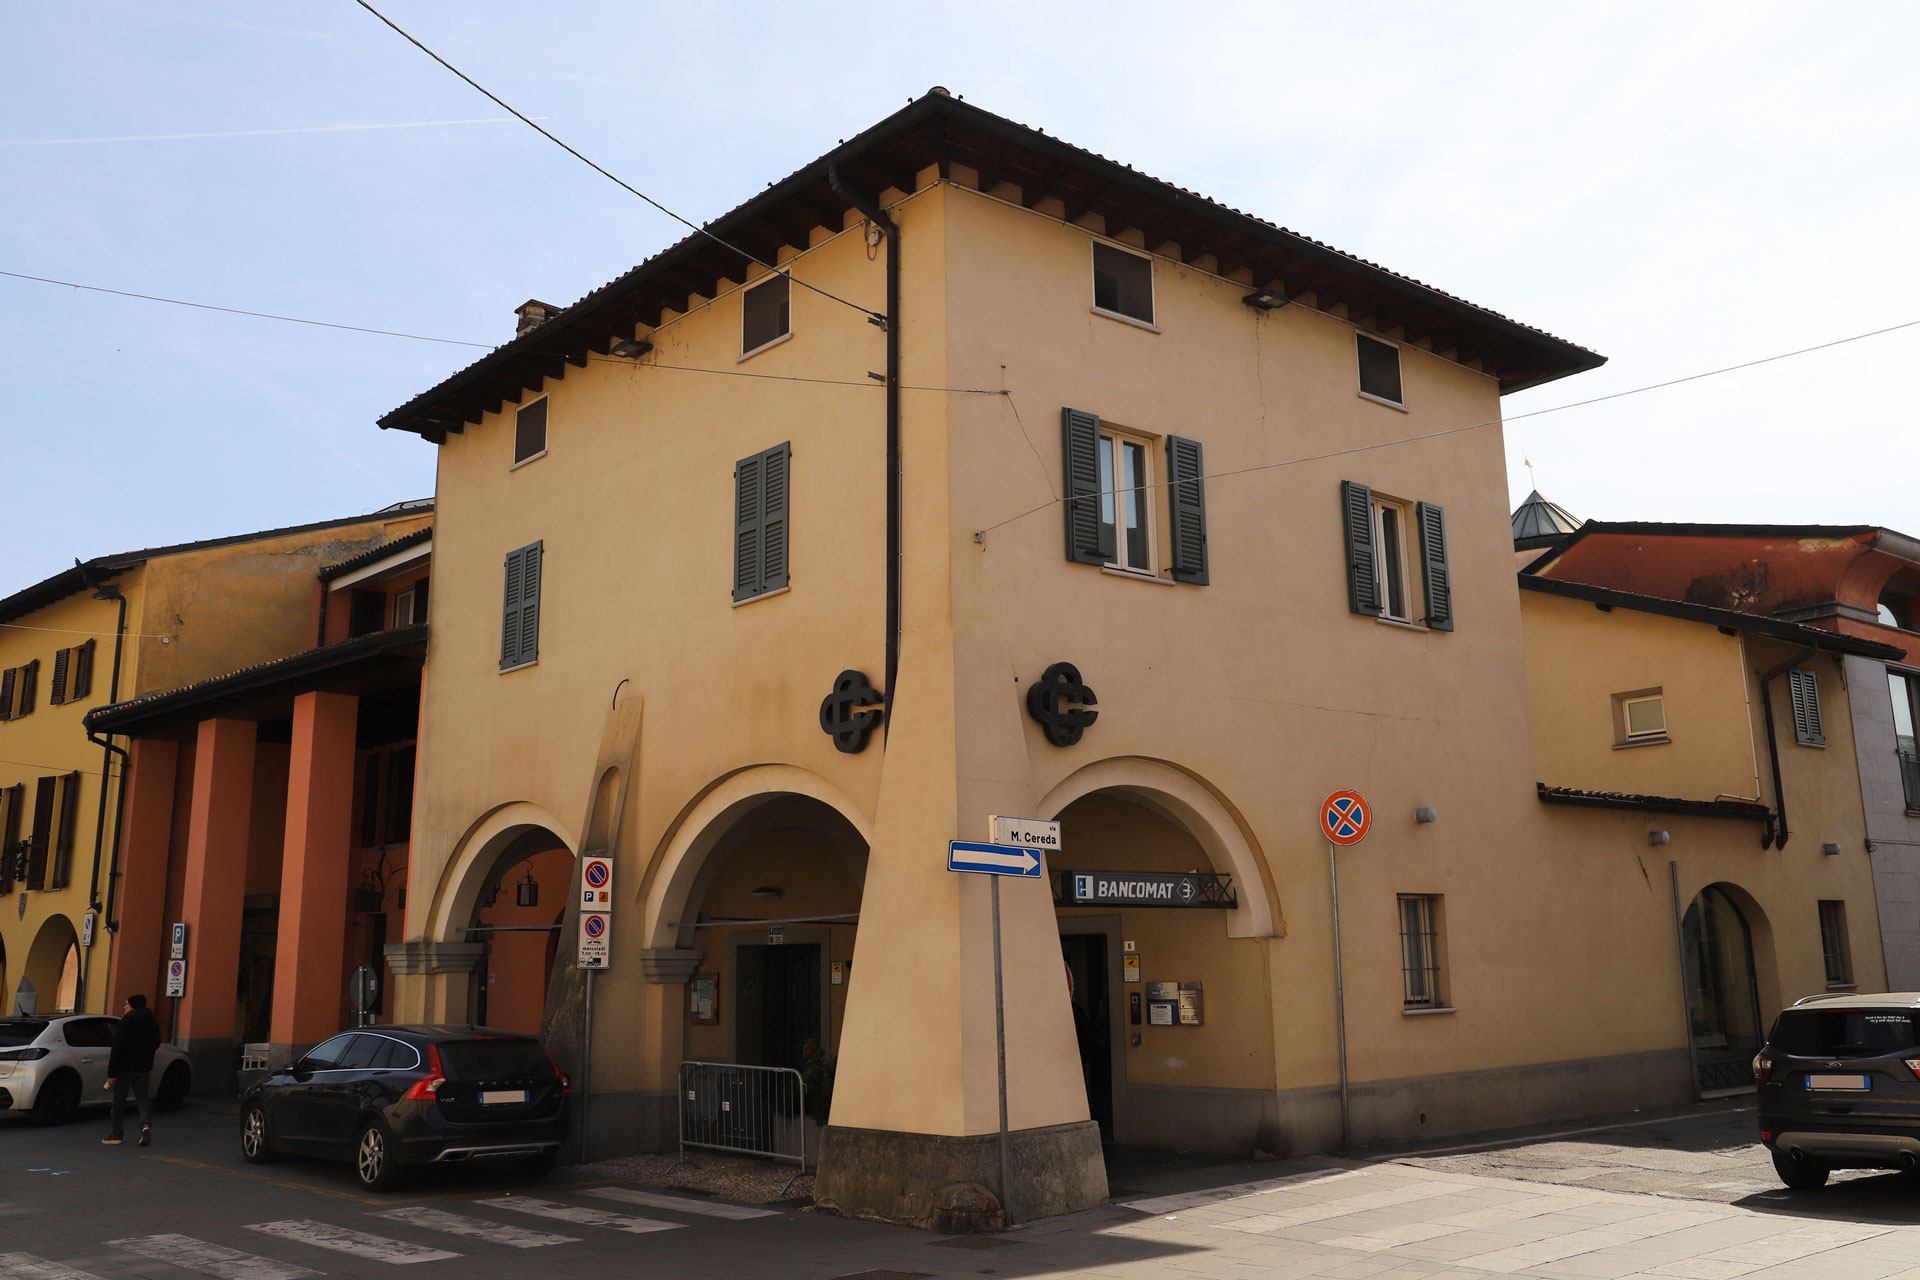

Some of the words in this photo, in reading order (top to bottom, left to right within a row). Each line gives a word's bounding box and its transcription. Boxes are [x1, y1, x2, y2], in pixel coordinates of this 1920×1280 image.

[1011, 831, 1022, 842] M.
[1025, 832, 1056, 845] Cereda
[1098, 880, 1175, 899] BANCOMAT
[175, 928, 181, 942] P
